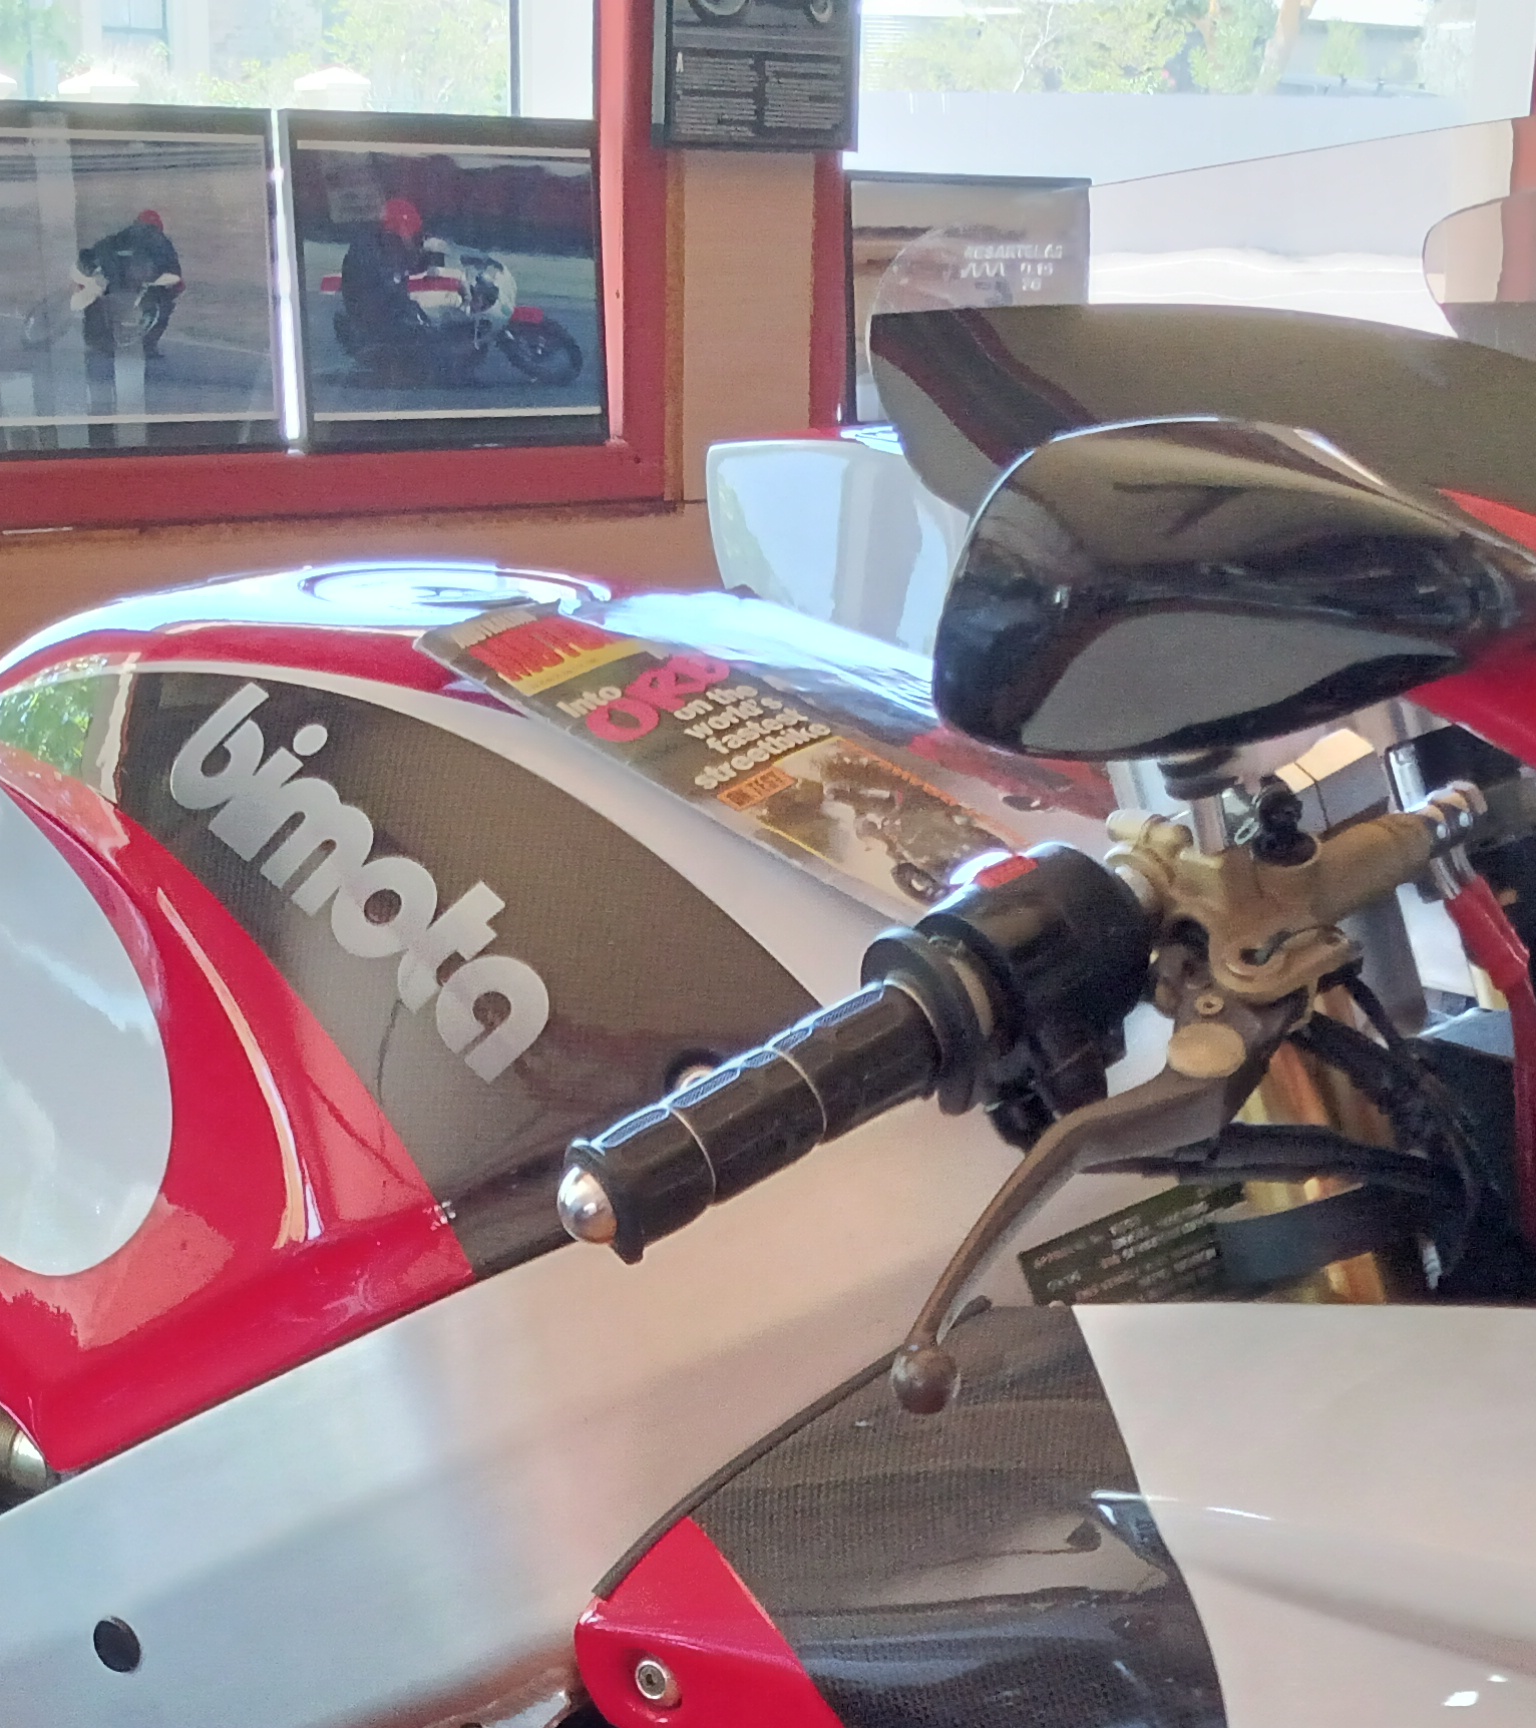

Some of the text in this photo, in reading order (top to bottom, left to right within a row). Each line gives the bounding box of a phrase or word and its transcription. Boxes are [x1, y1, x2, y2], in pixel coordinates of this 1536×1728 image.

[556, 686, 622, 718] Into
[673, 685, 758, 721] on the
[683, 697, 783, 739] world's
[706, 707, 809, 755] fastest
[694, 723, 831, 790] streetbike
[170, 682, 550, 1084] bimota
